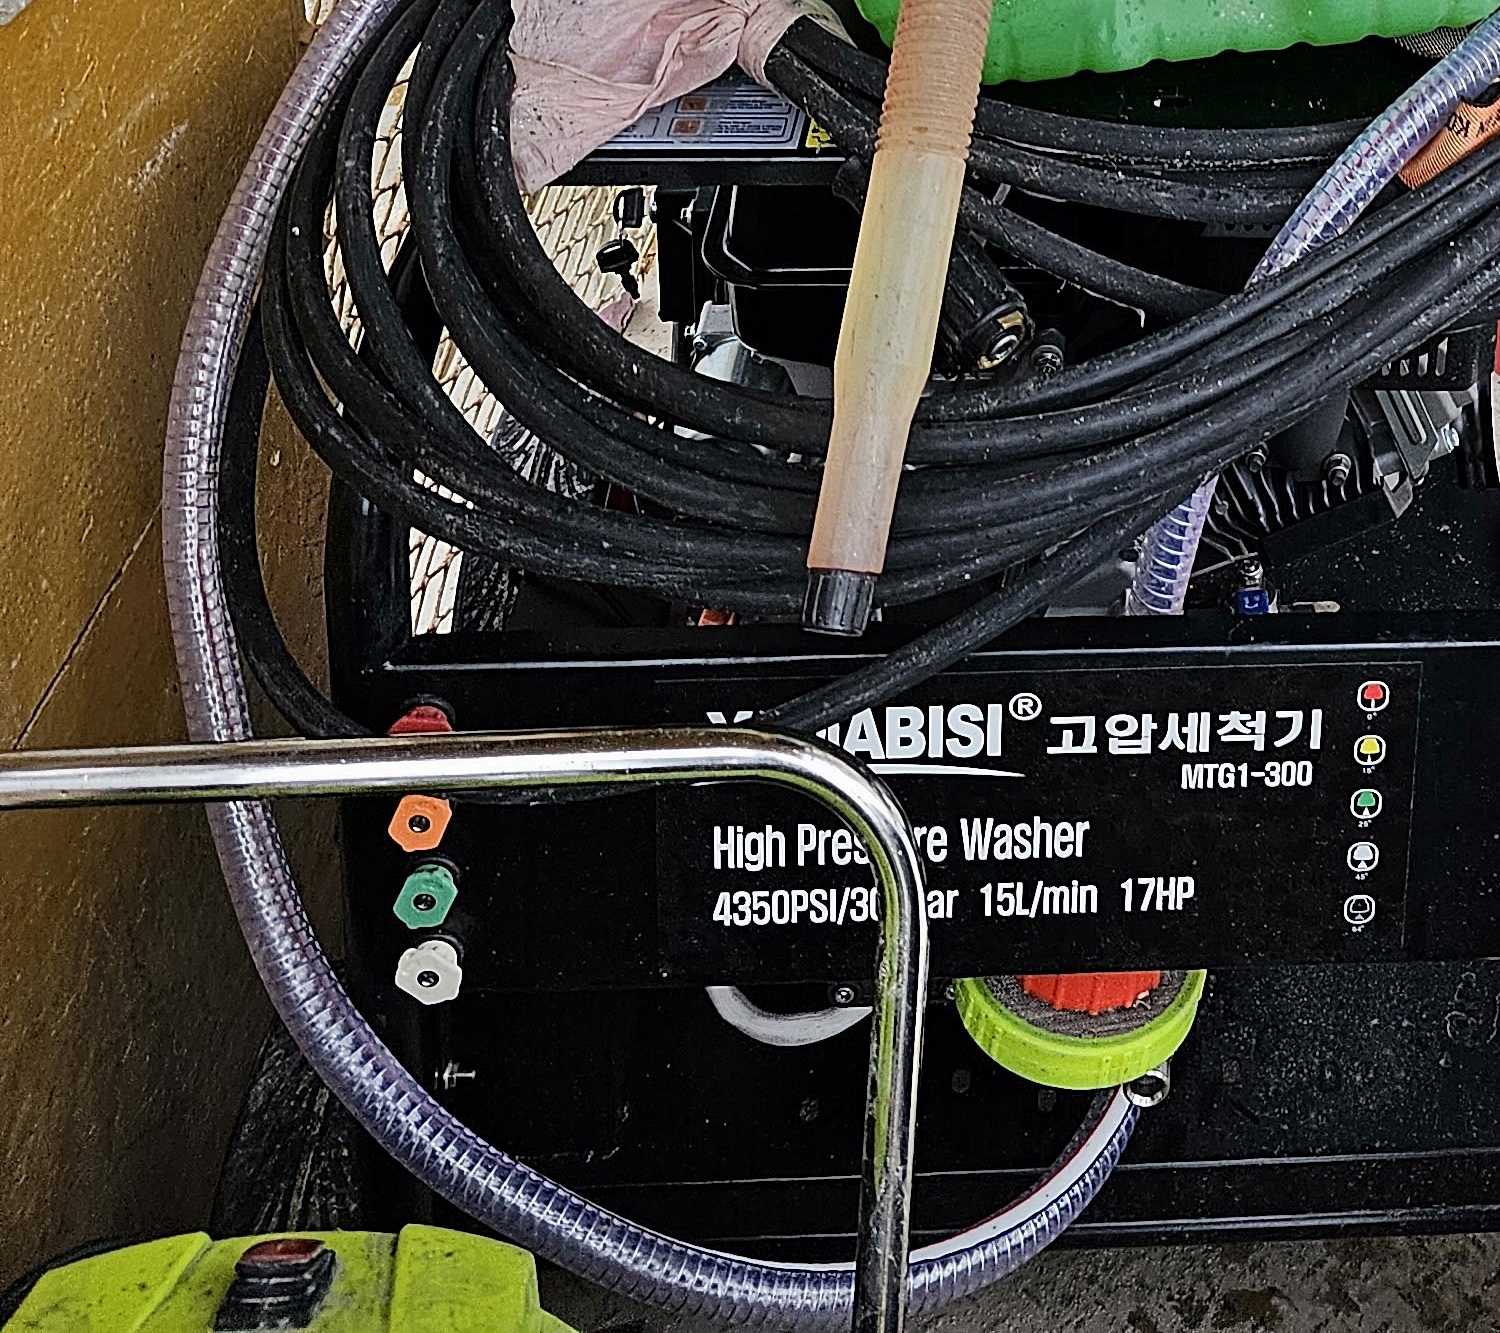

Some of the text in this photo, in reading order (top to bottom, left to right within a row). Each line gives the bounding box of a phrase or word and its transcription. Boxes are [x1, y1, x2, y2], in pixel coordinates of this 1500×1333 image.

[1046, 708, 1323, 755] 고압세척기
[1181, 761, 1313, 789] MTG1-300
[713, 815, 1091, 872] High Presre Washer
[979, 879, 1098, 918] 15L/min
[1120, 876, 1195, 912] 17HP
